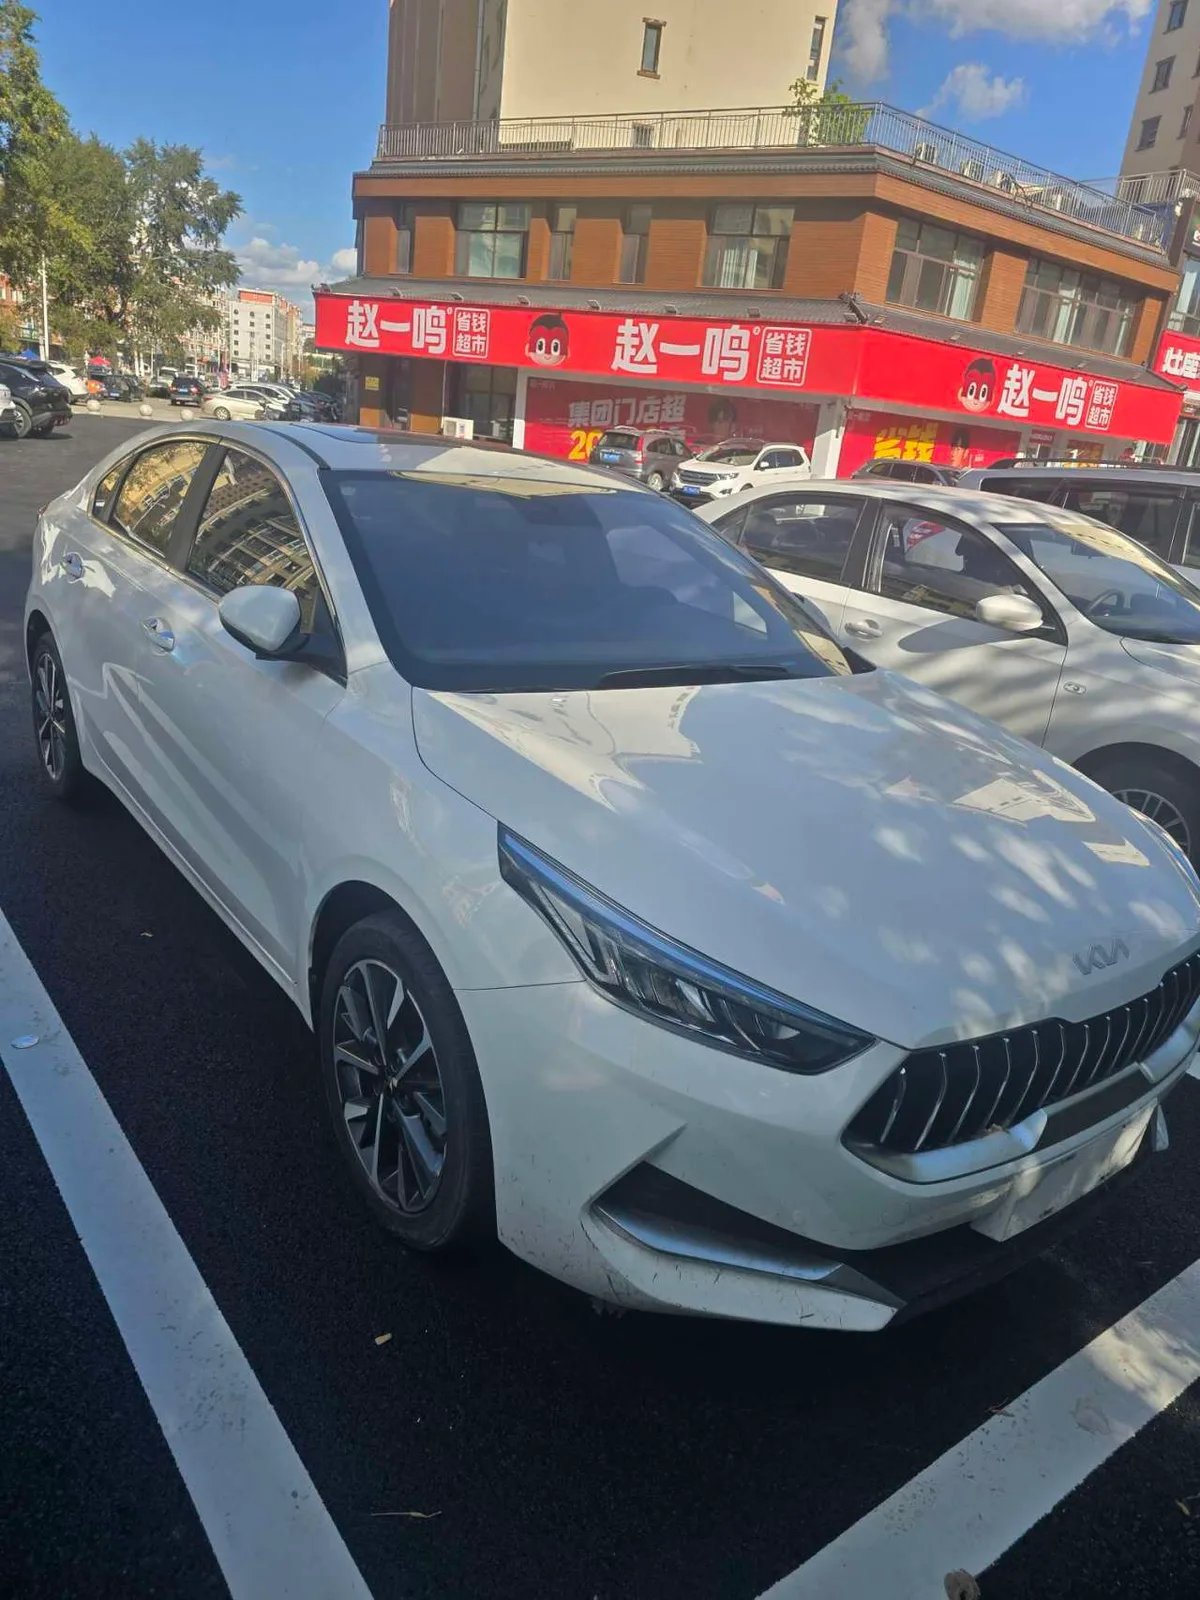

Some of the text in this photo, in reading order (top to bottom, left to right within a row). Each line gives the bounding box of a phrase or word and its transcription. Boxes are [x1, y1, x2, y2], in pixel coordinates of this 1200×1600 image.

[345, 300, 447, 354] 赵一鸣
[457, 312, 487, 333] 省钱
[456, 333, 486, 354] 超市
[610, 318, 751, 381] 赵一鸣
[764, 332, 806, 357] 省钱
[760, 356, 804, 381] 超市
[997, 363, 1088, 426] 赵一鸣
[1093, 384, 1116, 406] 省钱
[568, 394, 687, 427] 集团门店超
[1087, 405, 1111, 426] 超市
[1072, 938, 1130, 975] KIA
